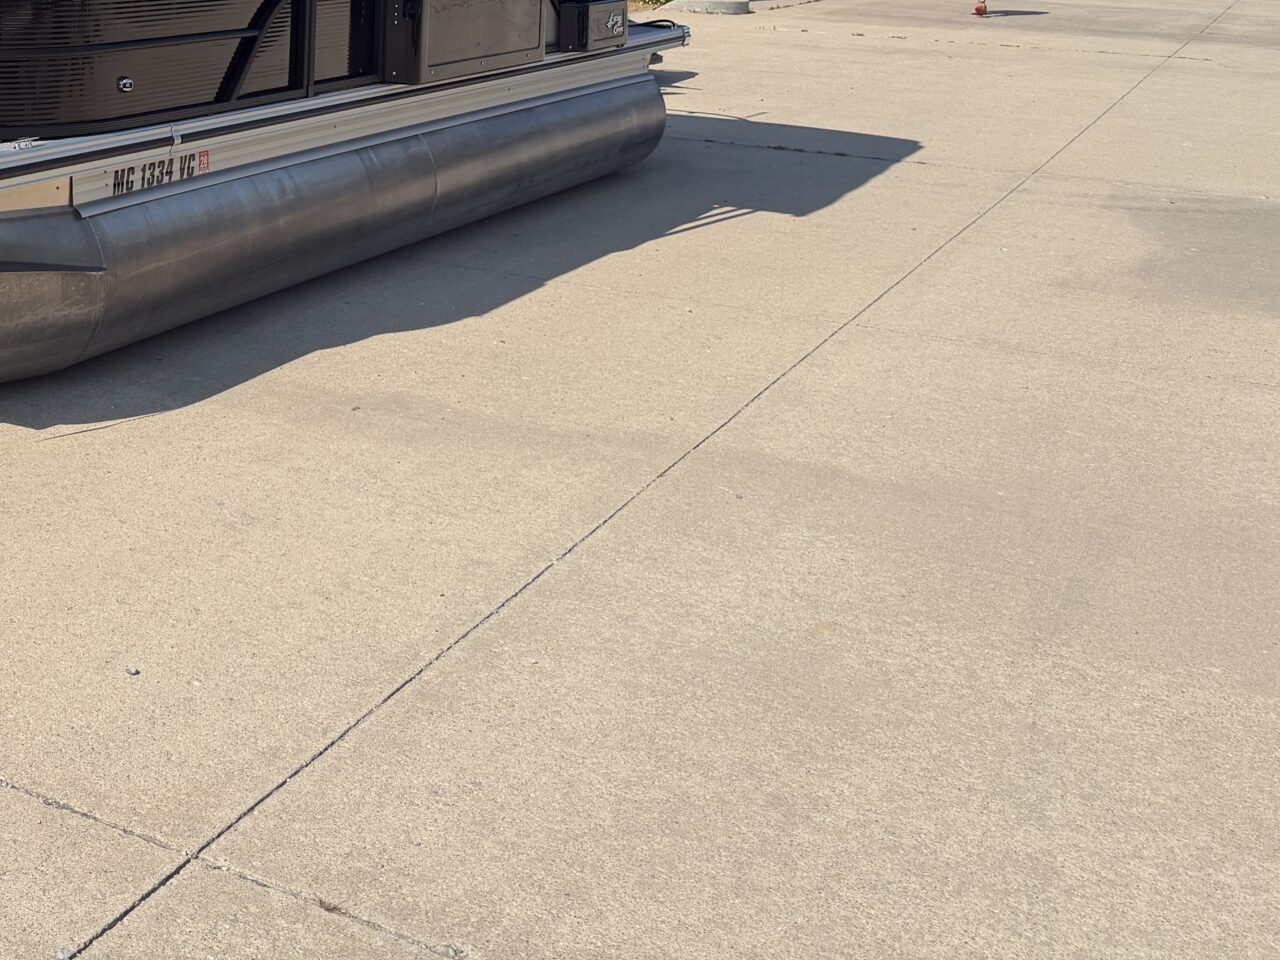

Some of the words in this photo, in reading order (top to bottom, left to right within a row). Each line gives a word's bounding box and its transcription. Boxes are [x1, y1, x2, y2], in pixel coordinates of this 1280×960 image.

[113, 167, 135, 194] MC
[141, 158, 173, 189] 1334
[180, 153, 195, 179] VC
